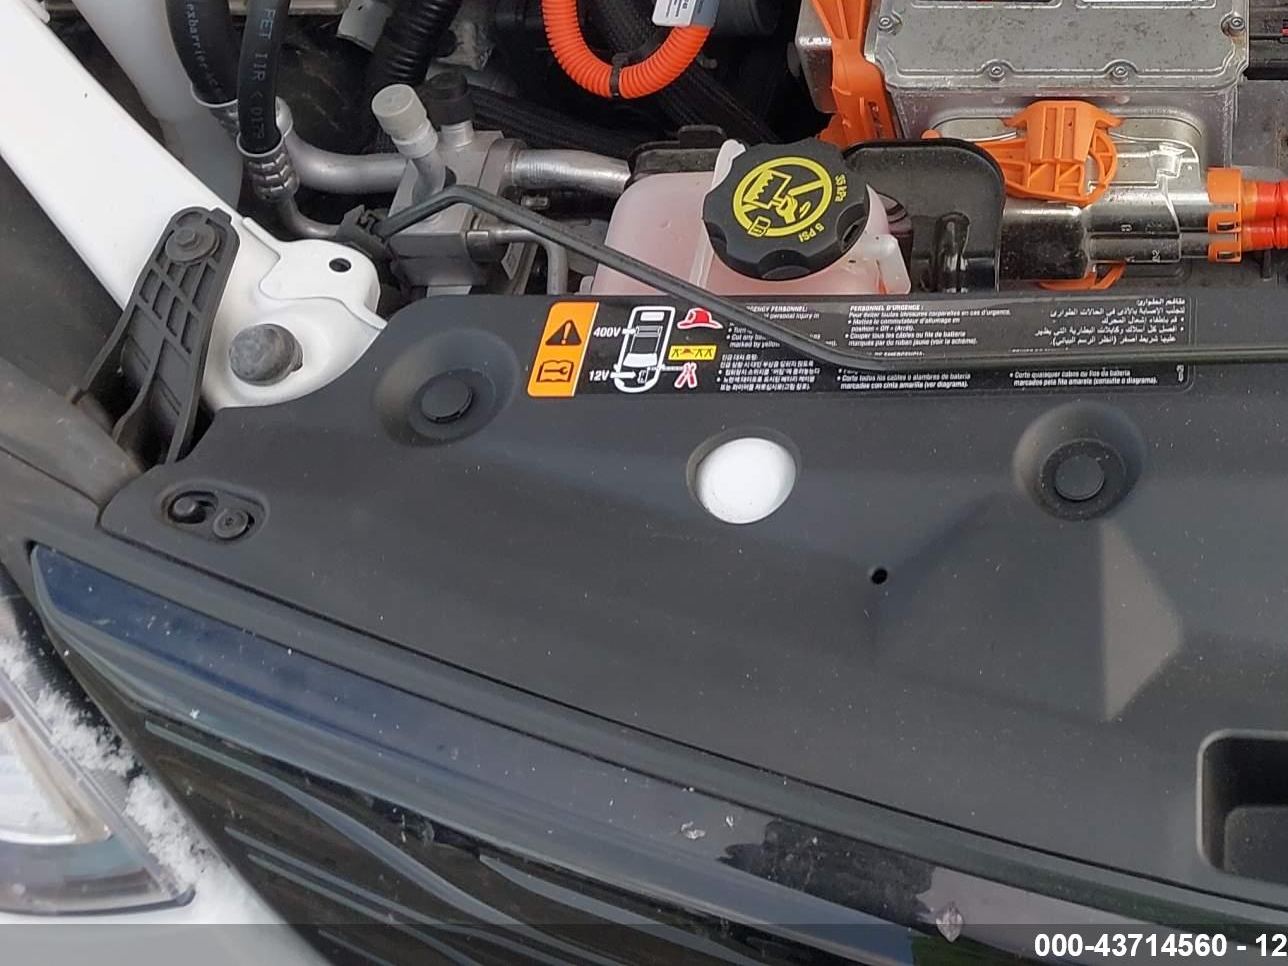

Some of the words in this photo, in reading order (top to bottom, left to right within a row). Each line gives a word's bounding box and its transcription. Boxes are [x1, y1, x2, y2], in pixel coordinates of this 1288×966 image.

[815, 223, 825, 233] 5
[799, 228, 815, 242] PSI
[592, 327, 622, 338] 400V
[589, 370, 611, 382] 12V
